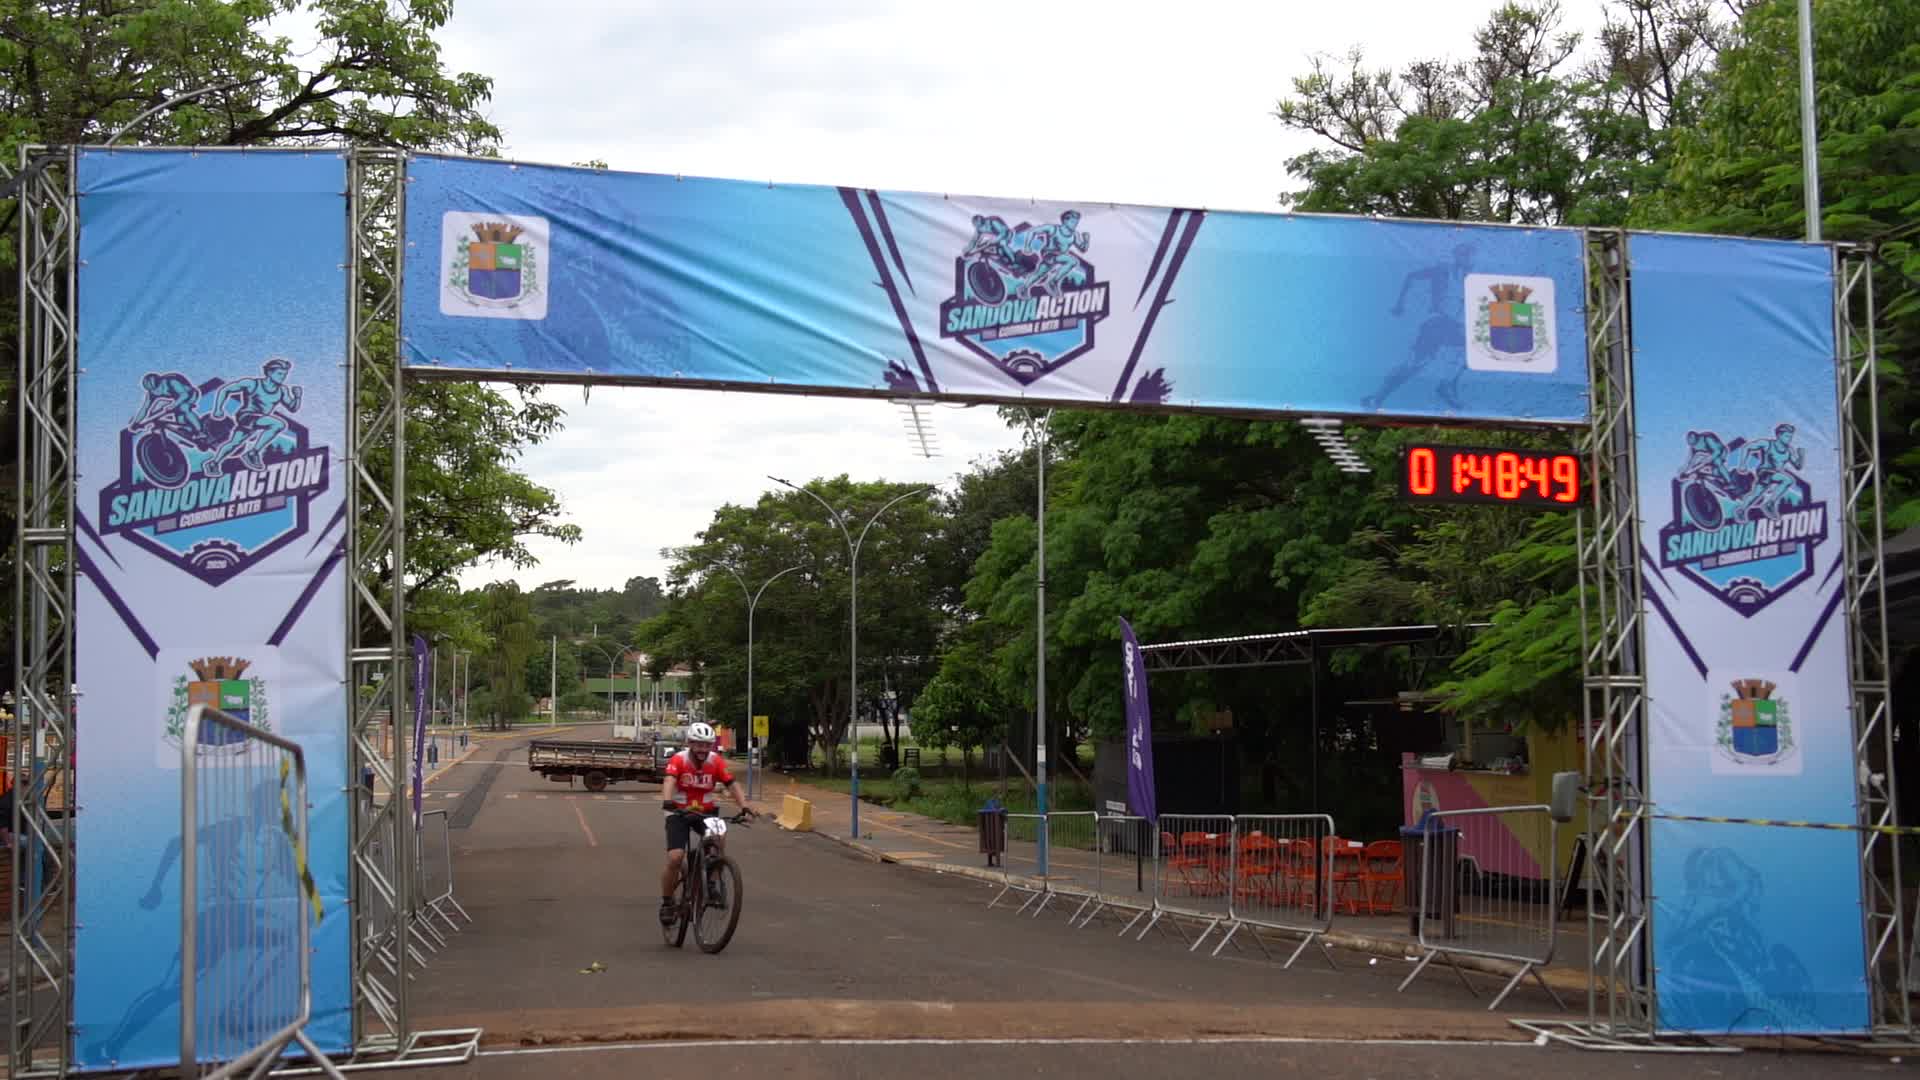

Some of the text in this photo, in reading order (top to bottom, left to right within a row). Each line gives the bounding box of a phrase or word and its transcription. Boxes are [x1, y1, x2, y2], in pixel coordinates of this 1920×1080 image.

[179, 499, 262, 528] CORRIDA E MTB
